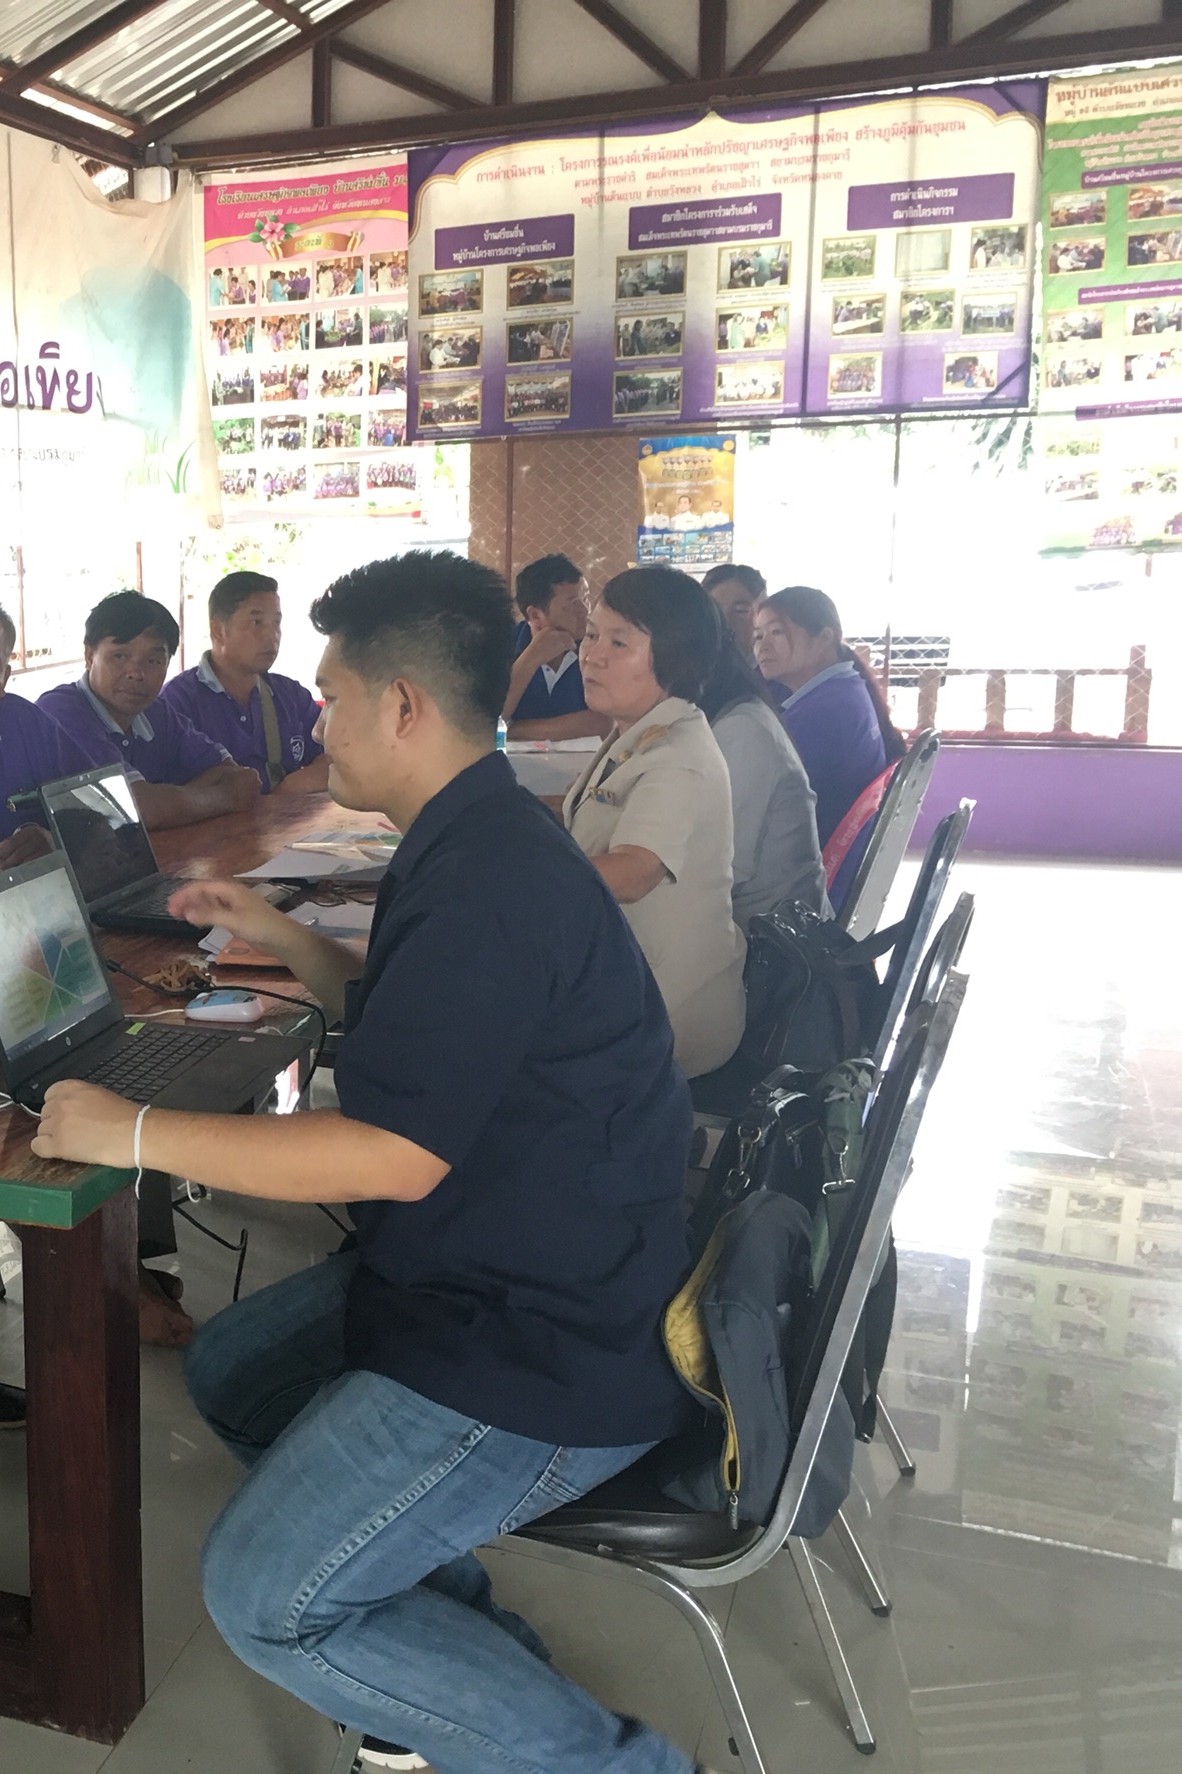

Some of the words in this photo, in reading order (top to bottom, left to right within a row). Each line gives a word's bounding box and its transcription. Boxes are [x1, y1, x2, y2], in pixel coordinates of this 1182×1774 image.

[476, 164, 546, 183] การดำเนินงาน
